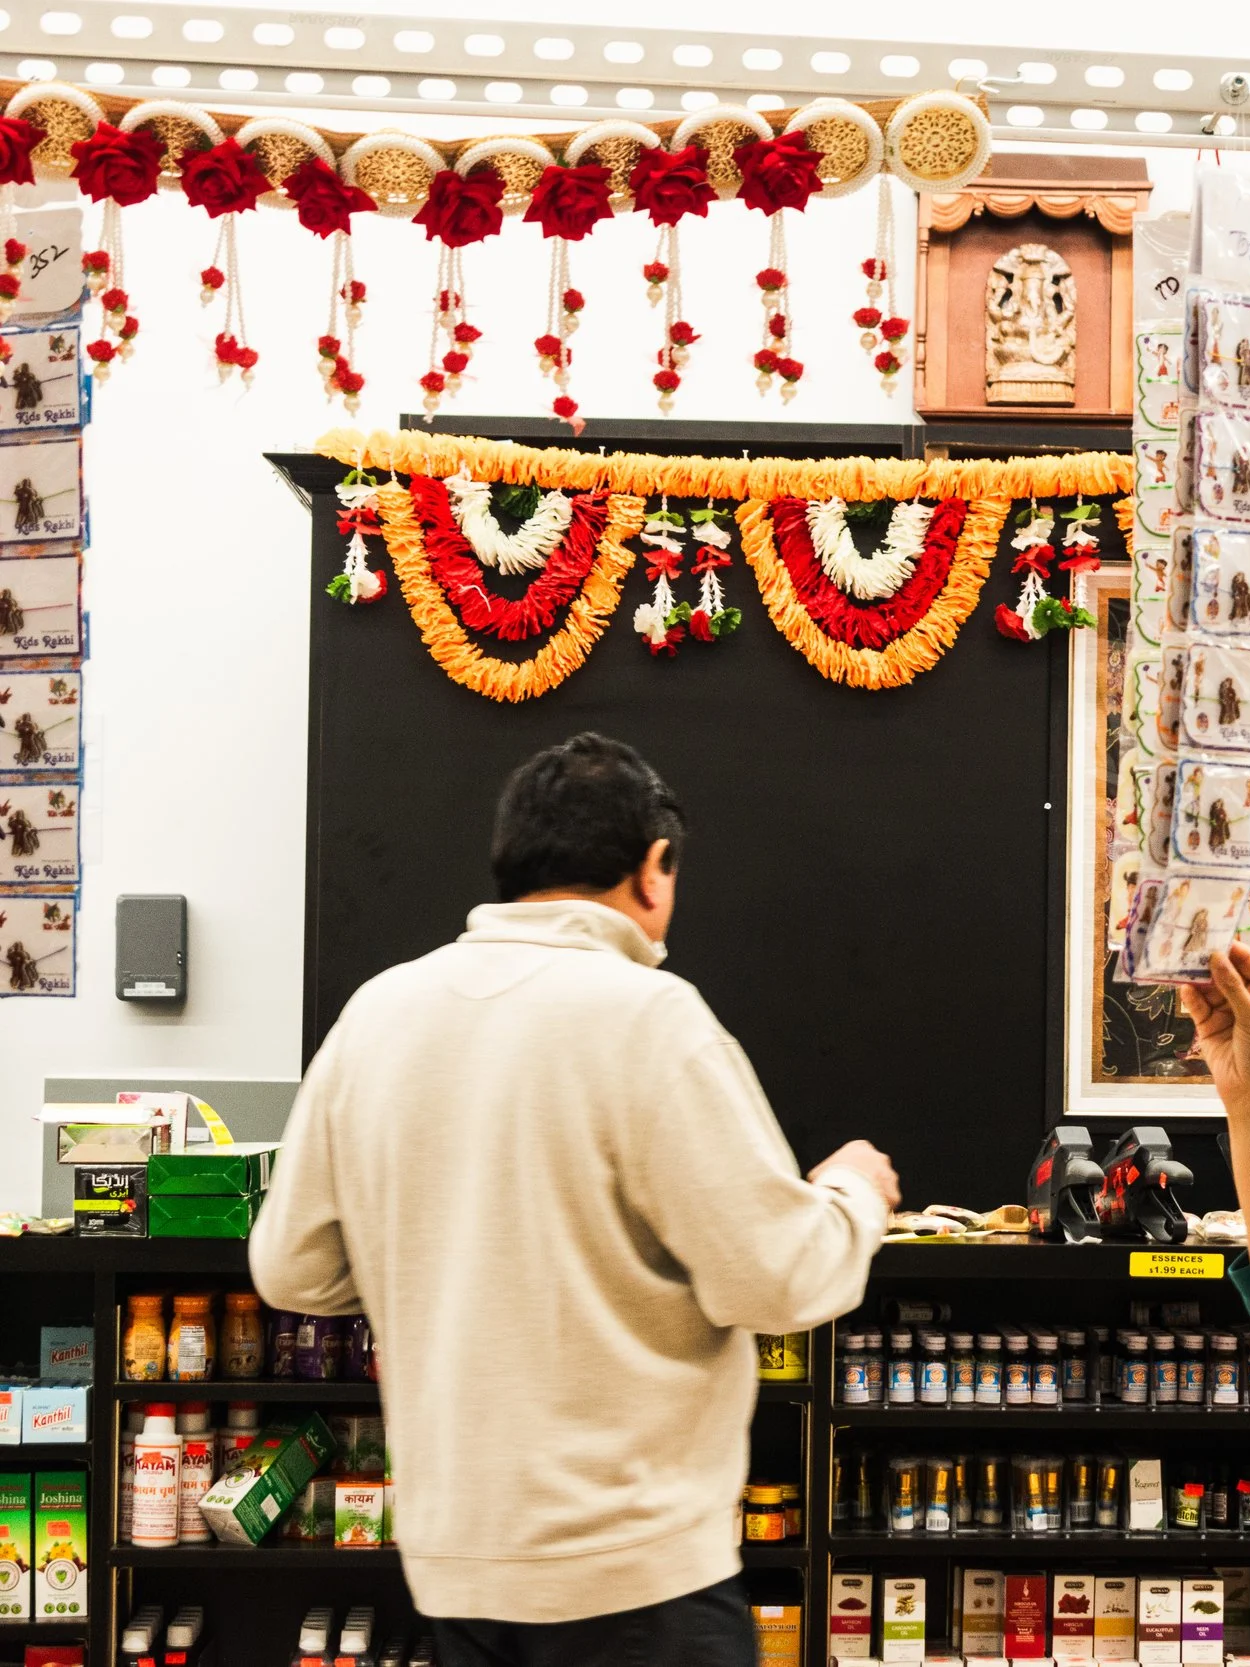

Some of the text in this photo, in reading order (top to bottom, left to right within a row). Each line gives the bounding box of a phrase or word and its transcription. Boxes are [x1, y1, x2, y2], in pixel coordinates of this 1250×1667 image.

[29, 244, 70, 279] 352
[1154, 276, 1180, 300] TD
[15, 408, 75, 425] Kids Rakhi
[15, 519, 75, 535] Kids Rakhi
[13, 635, 74, 650] Kids Rakhi
[42, 752, 75, 766] Rakhi
[14, 865, 75, 879] Kids Rakhi
[39, 978, 70, 992] Rakhi
[1151, 1255, 1203, 1263] ESSENCES
[1149, 1266, 1176, 1274] $1.99
[51, 1342, 88, 1365] Kanthil
[33, 1406, 72, 1428] Kanthil
[134, 1455, 176, 1476] KAYAM
[40, 1492, 83, 1504] Joshina
[344, 1494, 374, 1504] कायम
